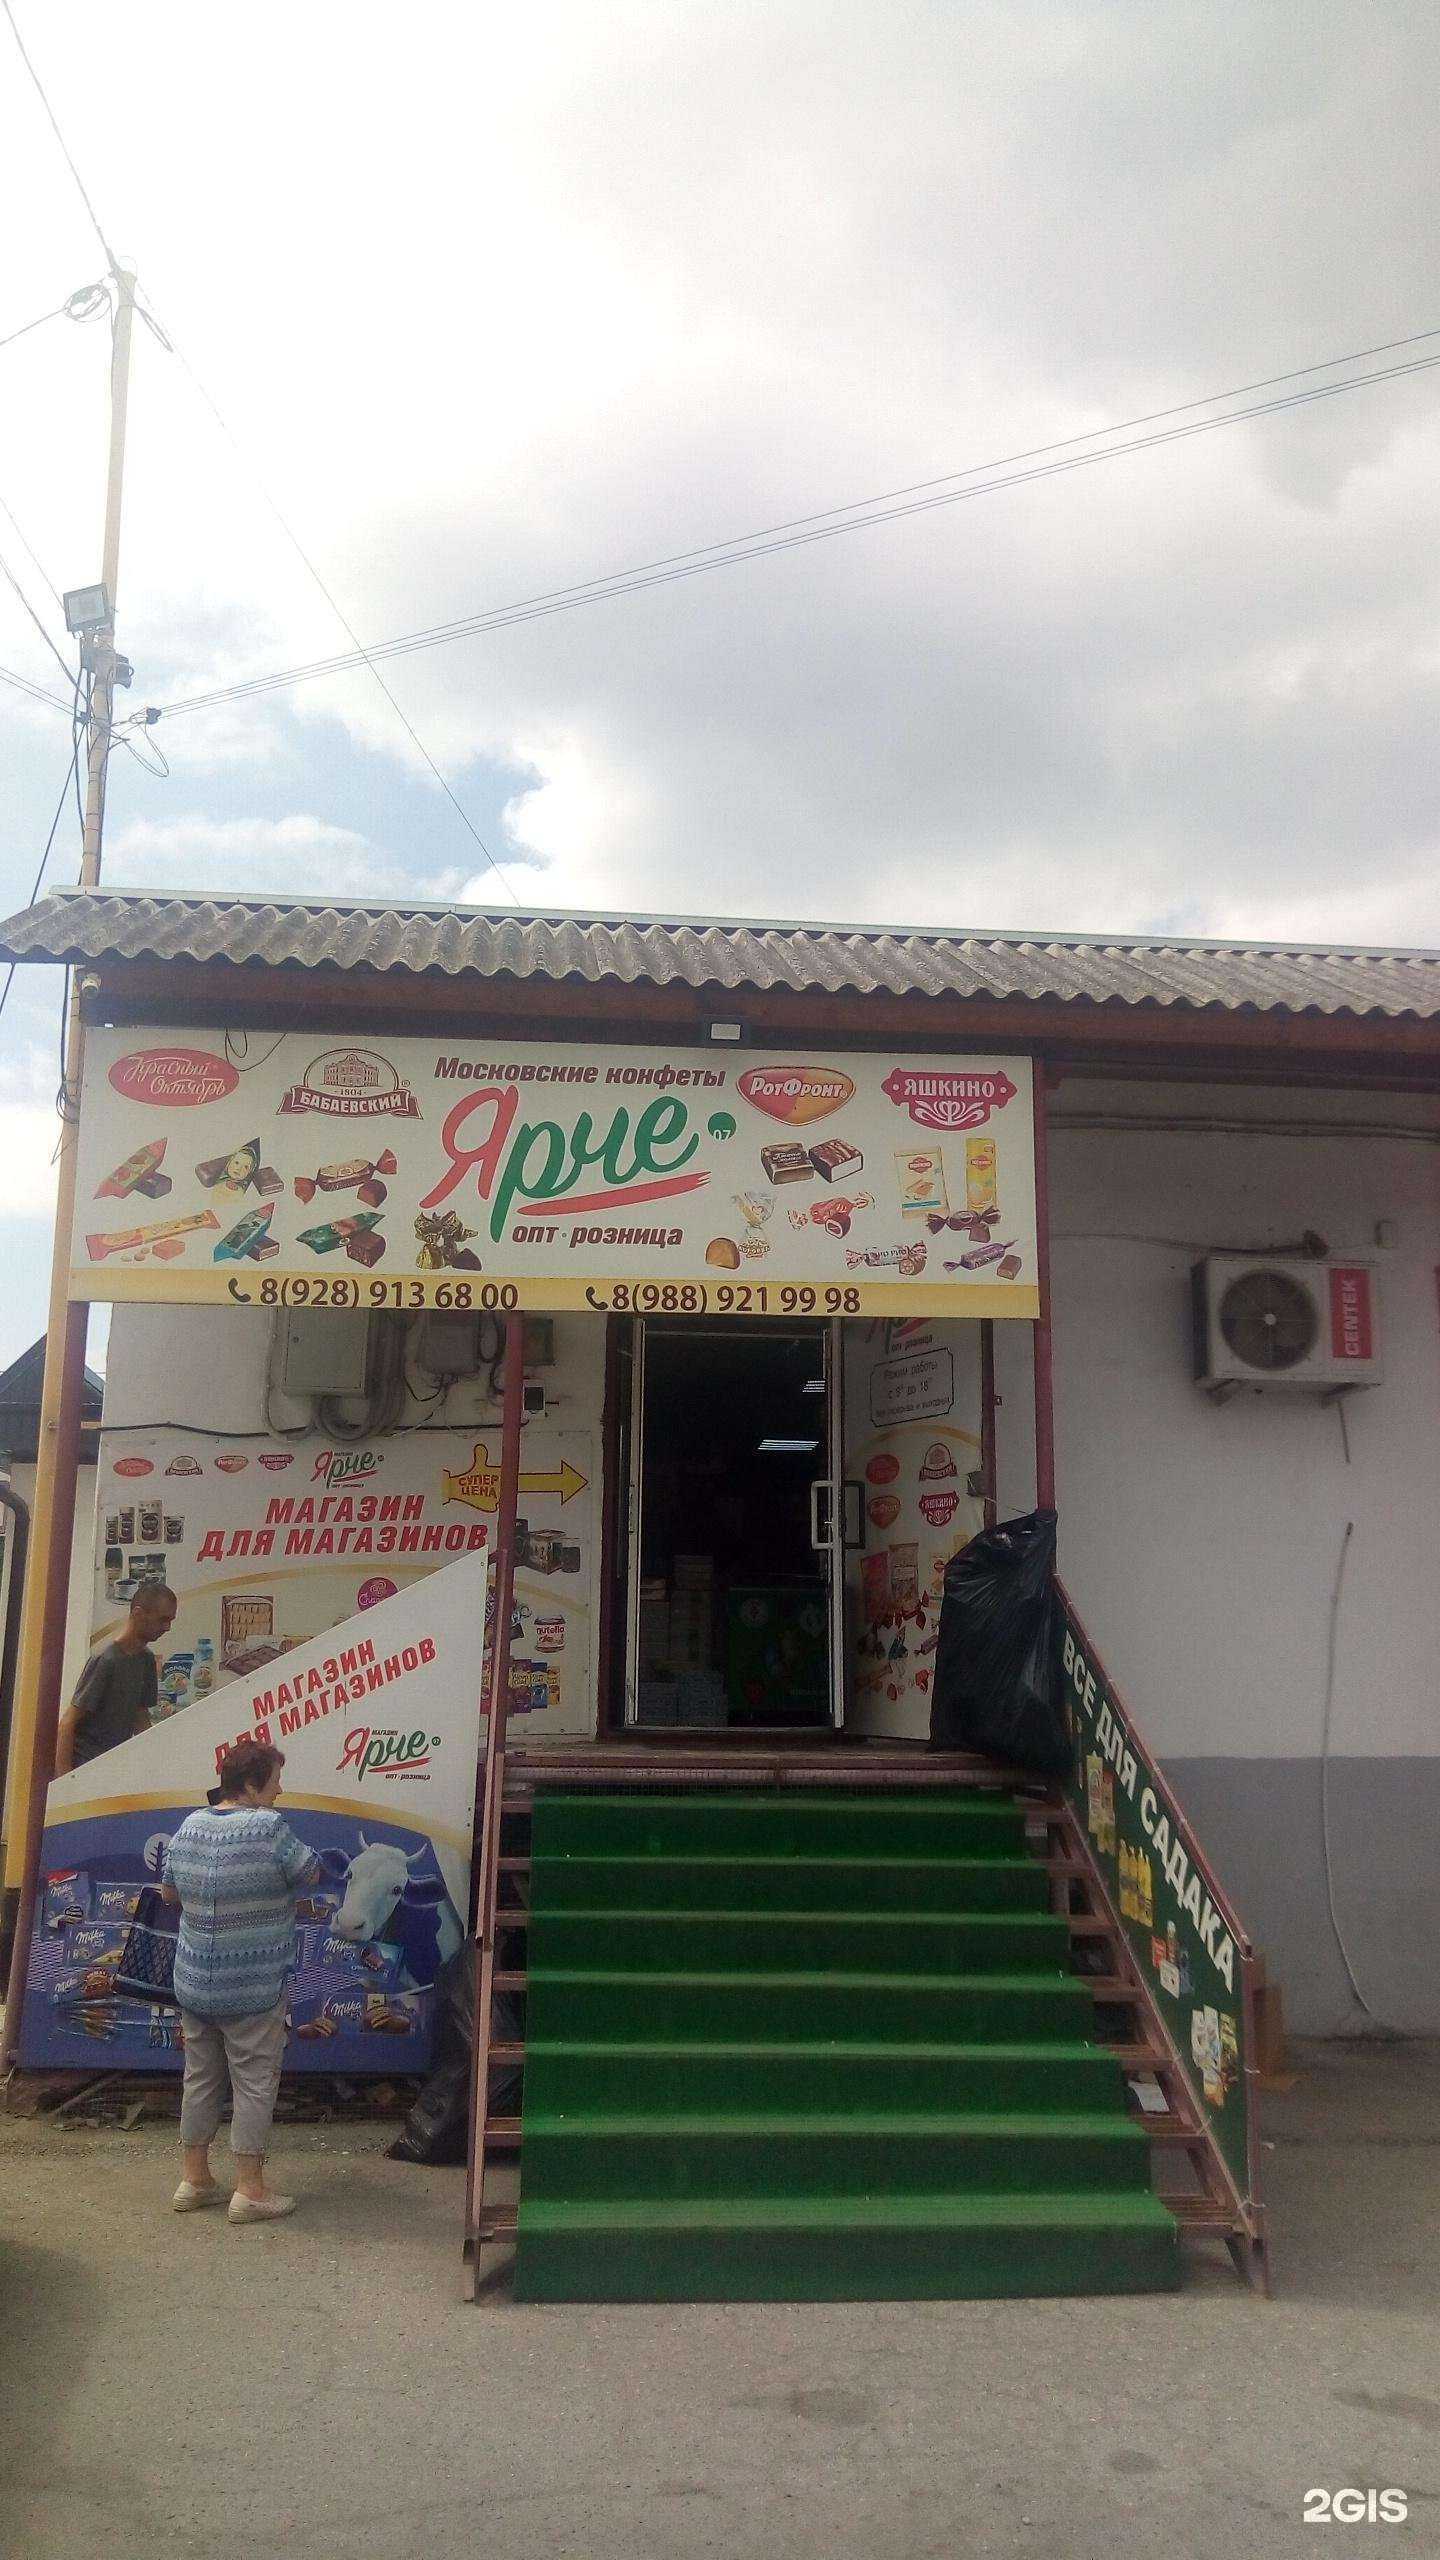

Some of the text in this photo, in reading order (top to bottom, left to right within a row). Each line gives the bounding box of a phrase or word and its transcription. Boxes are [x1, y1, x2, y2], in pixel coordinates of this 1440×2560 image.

[433, 1056, 727, 1090] Московские конфеты
[904, 1078, 996, 1098] ЯШКИНО
[150, 1075, 226, 1104] Октябрь
[419, 1084, 701, 1243] Ярче
[512, 1225, 683, 1248] опт розница
[259, 1278, 518, 1310] 8(928) 913 68 00
[612, 1283, 861, 1314] 8(988) 921 99 98
[310, 1450, 376, 1489] Ярче
[458, 1474, 499, 1487] СУПЕР
[461, 1486, 498, 1499] ЦЕНА
[265, 1494, 425, 1524] МАГАЗИН
[196, 1524, 488, 1562] ДЛЯ МАГАЗИНОВ
[536, 1625, 565, 1635] nutella
[252, 1638, 377, 1721] МАГАЗИН
[278, 1637, 437, 1737] МАГАЗИНОВ
[336, 1726, 430, 1782] Ярче
[1062, 1630, 1234, 1995] ВСЕ ДЛЯ САДАКА
[99, 1889, 126, 1906] Milka
[75, 1928, 106, 1945] Milka
[330, 2000, 361, 2017] Milka
